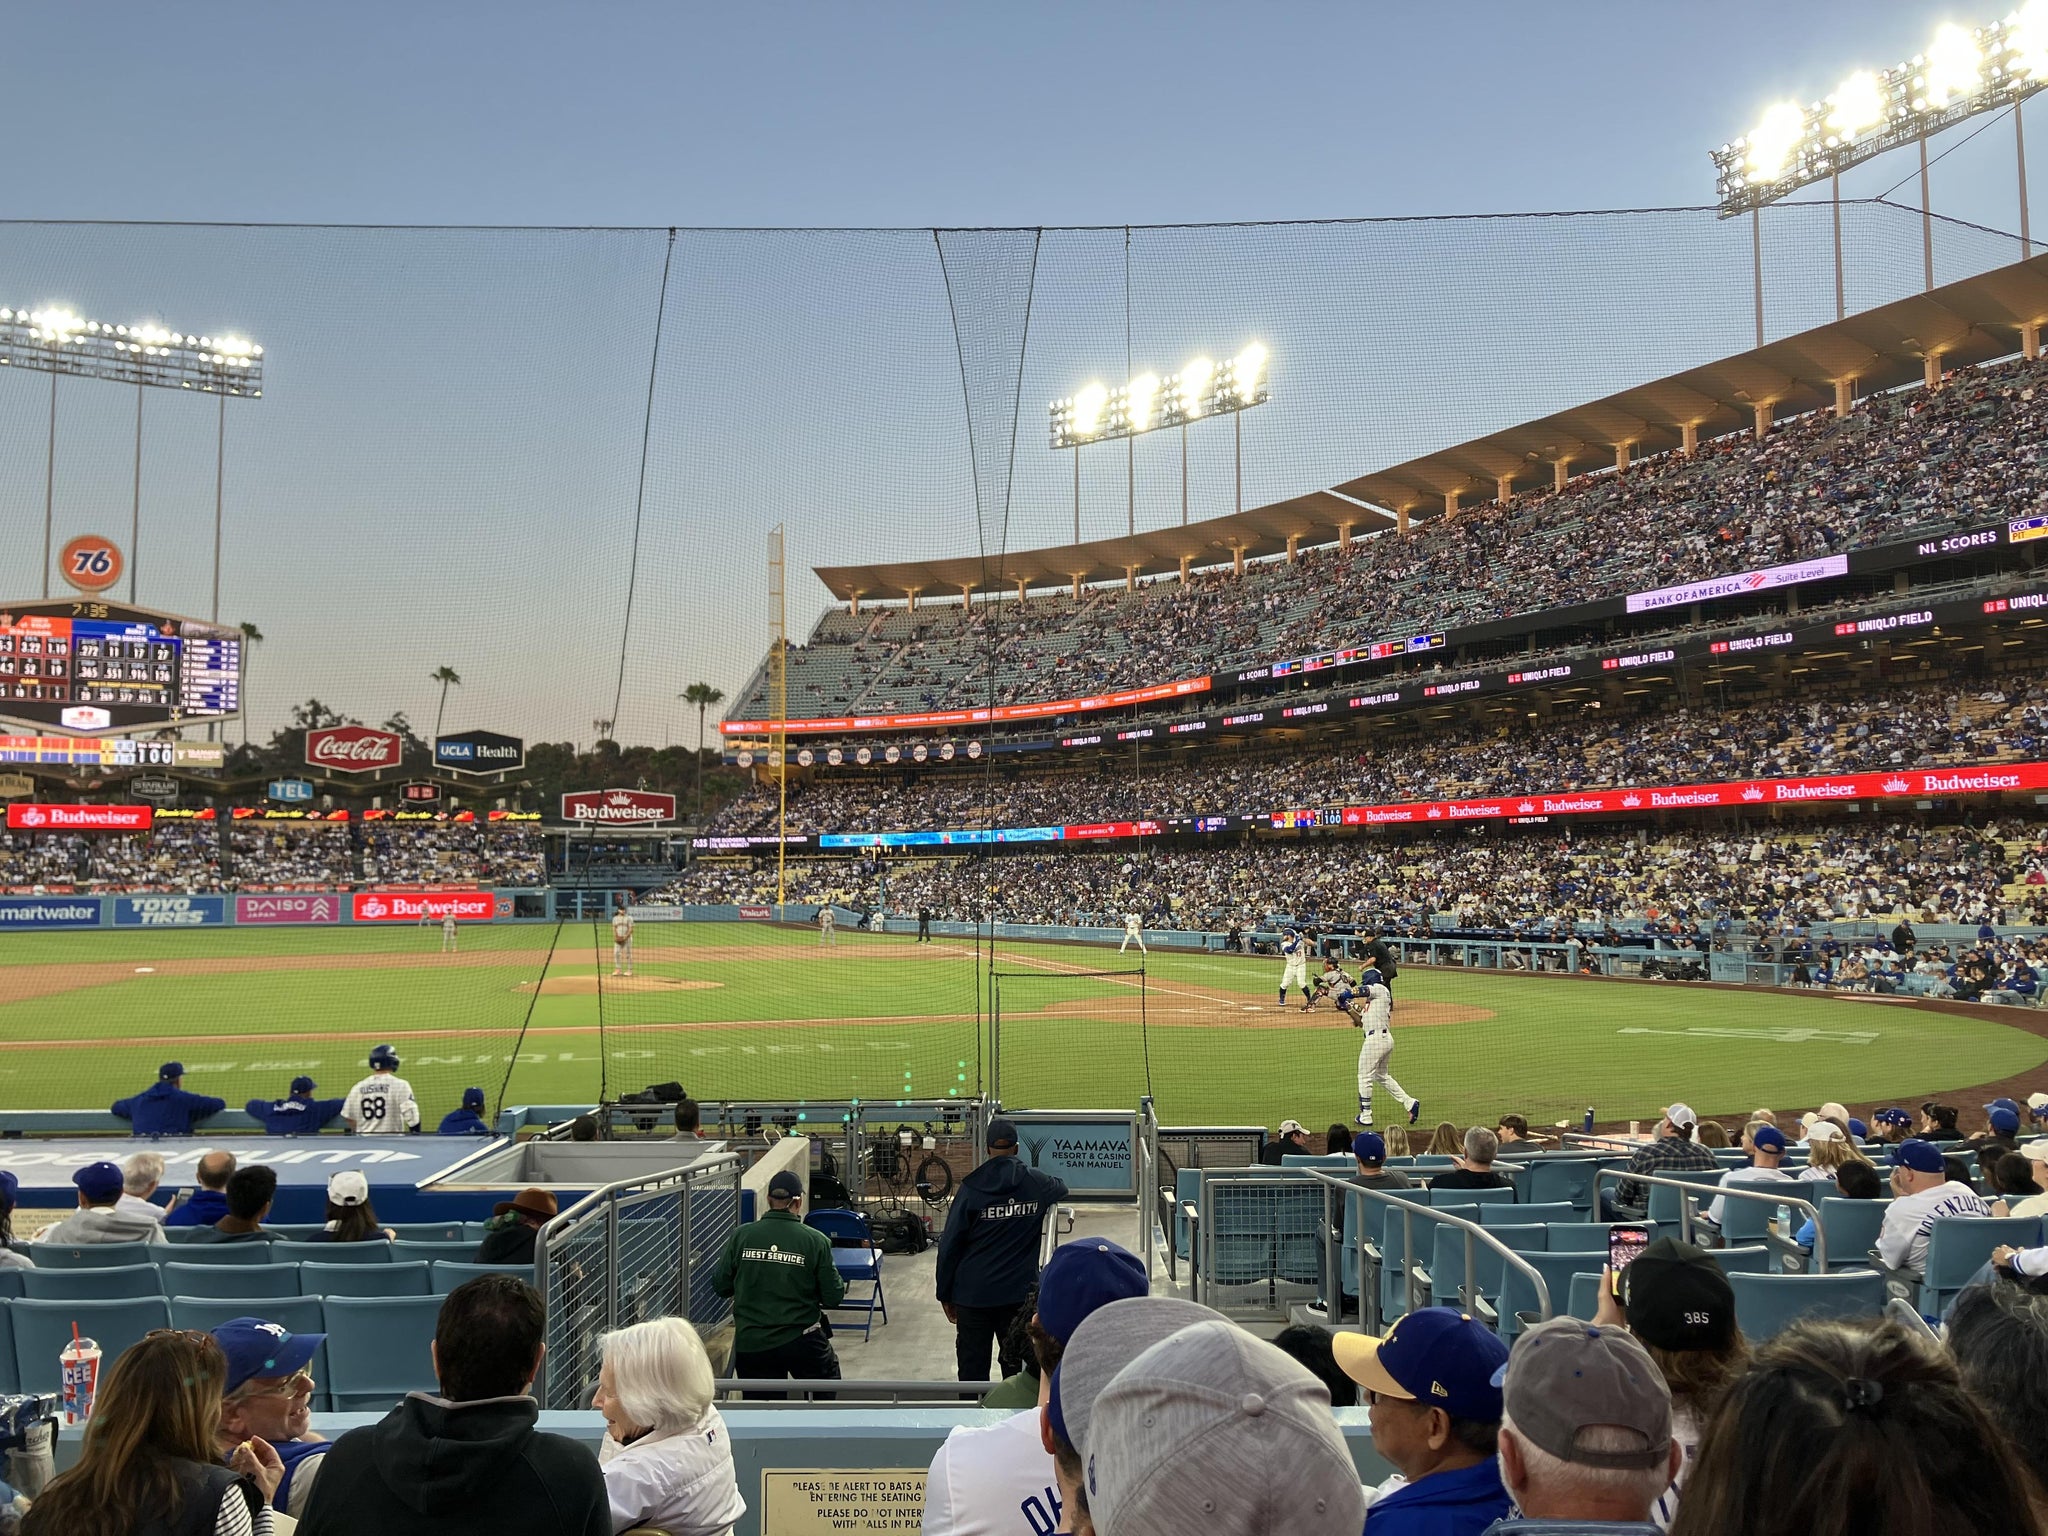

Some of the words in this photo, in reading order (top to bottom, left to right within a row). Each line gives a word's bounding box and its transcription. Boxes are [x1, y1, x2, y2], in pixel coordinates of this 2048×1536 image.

[2012, 522, 2031, 532] COL
[2041, 518, 2048, 526] 2
[2012, 532, 2026, 540] PIT
[2042, 527, 2048, 535] 7
[1919, 542, 1937, 555] NL
[1942, 531, 1996, 550] SCORES
[73, 548, 112, 575] 76
[1645, 595, 1673, 608] BANK
[1676, 592, 1690, 602] OF
[1692, 582, 1740, 599] AMERICA
[1776, 573, 1798, 584] Suite
[1800, 566, 1824, 579] Level
[2010, 594, 2048, 609] UNIQL
[72, 602, 108, 618] 7:35
[1858, 616, 1896, 631] UNIQLO
[1899, 612, 1932, 625] FIELD
[1729, 638, 1762, 651] UNIQLO
[1764, 632, 1792, 645] FIELD
[1619, 655, 1648, 667] UNIQLO
[1650, 650, 1674, 662] FIELD
[1246, 669, 1268, 679] SCORES
[1522, 670, 1548, 682] UNIQLO
[1549, 666, 1570, 676] FIELD
[1437, 684, 1459, 695] UNIQLO
[1460, 680, 1480, 691] FIELD
[1361, 695, 1381, 705] UNIQLO
[1382, 693, 1399, 703] FIELD
[1293, 706, 1311, 716] UNIQLO
[1312, 704, 1327, 712] FIELD
[1232, 715, 1249, 724] UNIQLO
[1249, 713, 1263, 721] FIELD
[315, 735, 392, 760] Coca-Cola
[440, 745, 470, 757] UCLA
[477, 745, 517, 758] Health
[274, 783, 307, 799] TEL
[50, 808, 140, 825] Budweiser
[131, 898, 191, 912] TOYO
[247, 900, 307, 911] DAISO
[392, 899, 486, 915] Budweiser
[140, 911, 204, 924] TIRES
[741, 908, 770, 917] Yakult
[361, 1096, 386, 1120] 68
[980, 1202, 1038, 1218] SECURITY
[1684, 1312, 1710, 1324] 385
[793, 1482, 825, 1491] PLEASE
[830, 1482, 839, 1491] BE
[843, 1482, 870, 1491] ALERT
[873, 1482, 886, 1491] TO
[890, 1482, 912, 1491] BATS
[861, 1493, 877, 1502] THE
[881, 1493, 921, 1502] SEATING
[817, 1509, 850, 1517] PLEASE
[854, 1509, 868, 1517] DO
[896, 1509, 924, 1517] INTER
[833, 1520, 856, 1528] WITH
[862, 1520, 887, 1528] ALLS
[891, 1520, 901, 1528] IN
[905, 1520, 923, 1528] PLA
